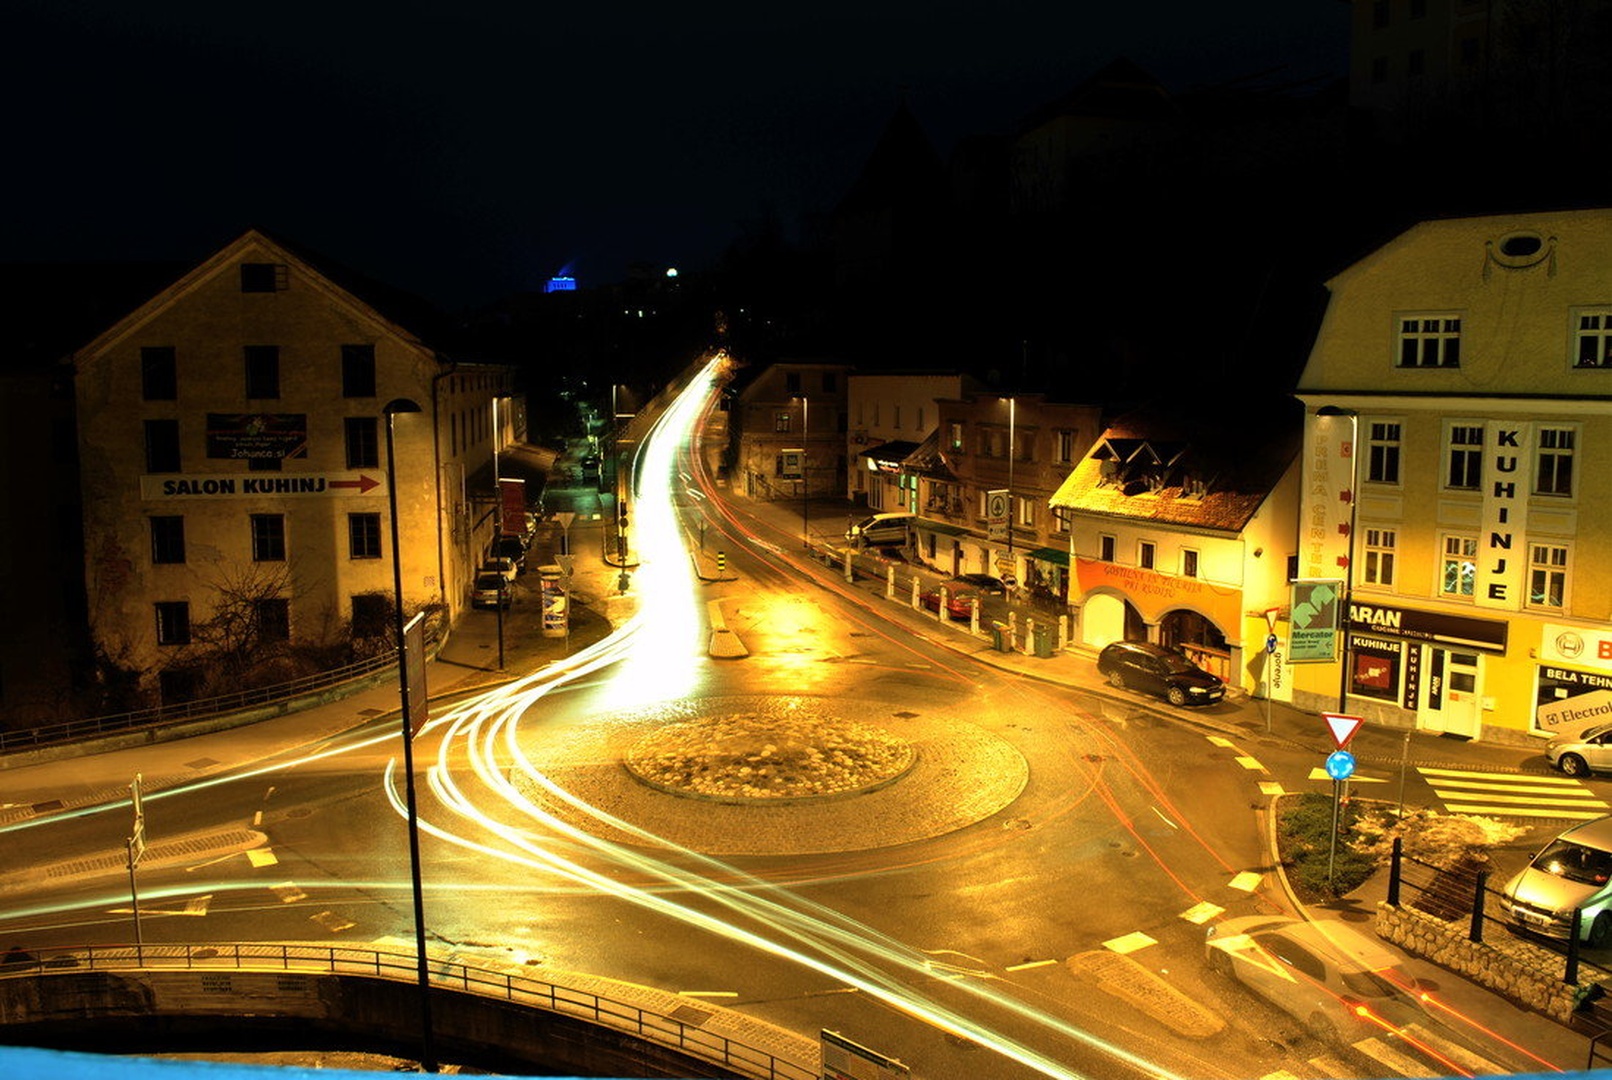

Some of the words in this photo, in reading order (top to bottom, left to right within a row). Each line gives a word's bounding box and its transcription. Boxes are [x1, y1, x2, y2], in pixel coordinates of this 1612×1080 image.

[163, 479, 235, 495] SALON
[243, 477, 326, 494] KUHINJ
[1488, 430, 1519, 600] KUHINJE
[1350, 606, 1401, 628] ARAN
[1292, 631, 1333, 639] Mercator
[1353, 637, 1400, 653] KUHINJE
[1273, 652, 1281, 689] gorenje
[1407, 647, 1418, 708] KUHINJE
[1547, 668, 1578, 682] BELA
